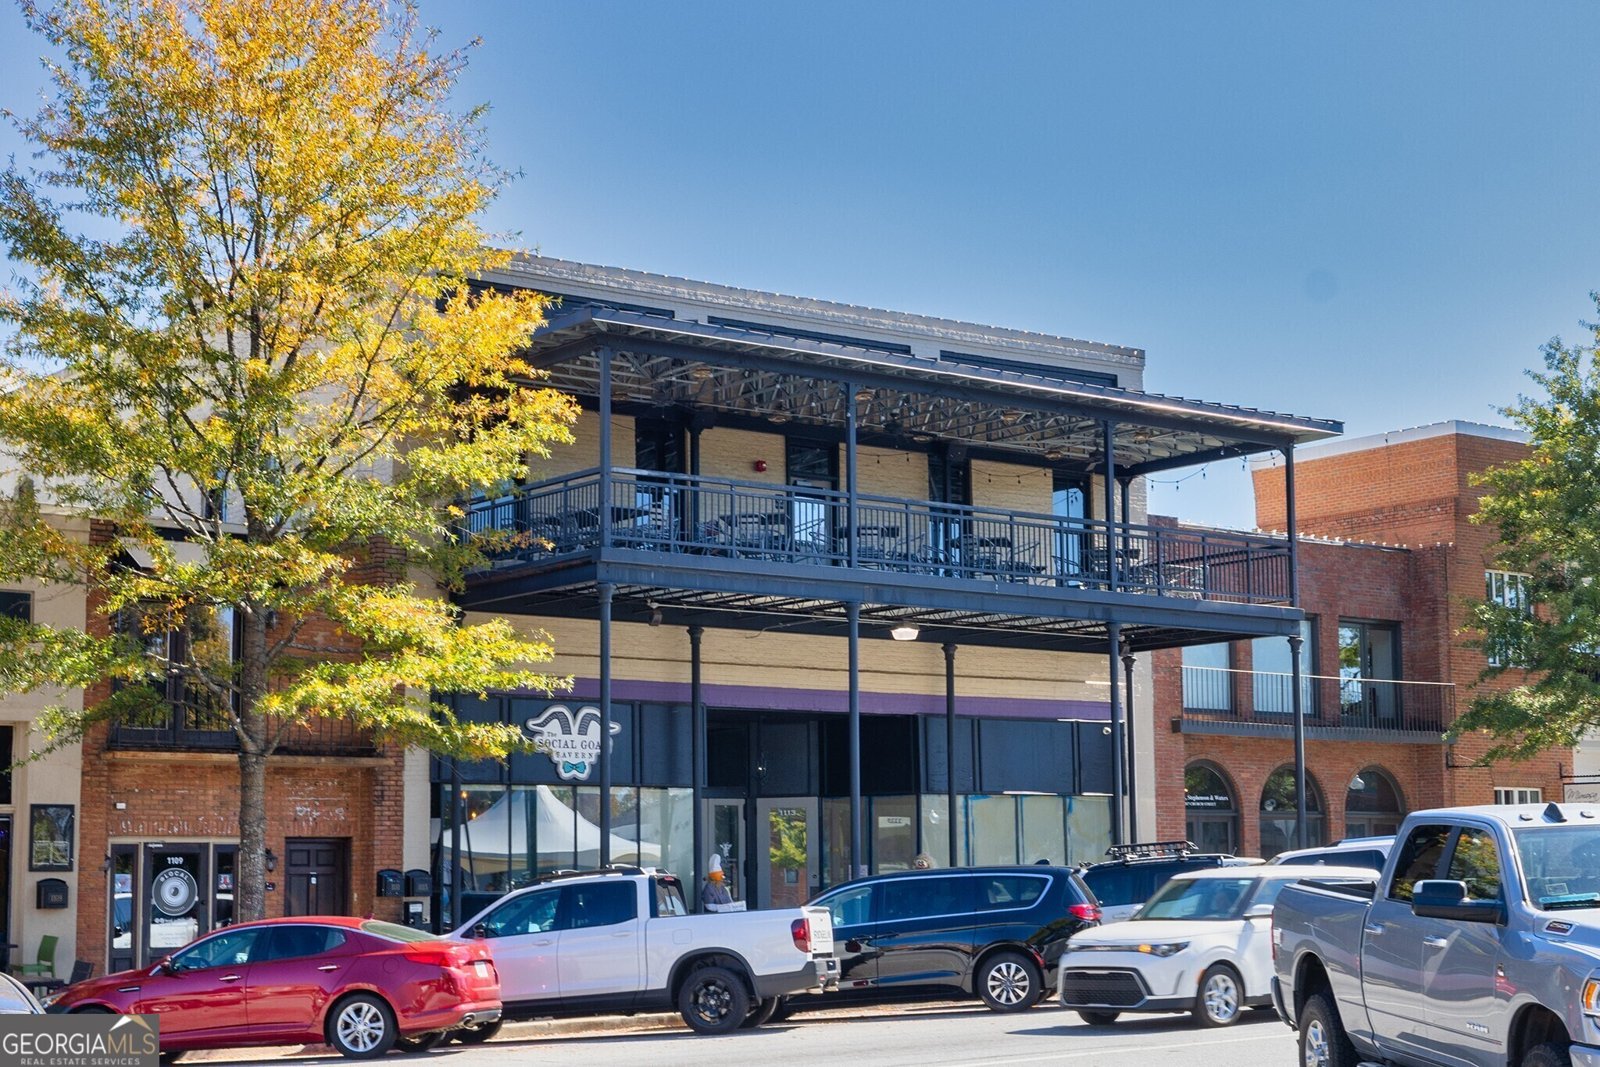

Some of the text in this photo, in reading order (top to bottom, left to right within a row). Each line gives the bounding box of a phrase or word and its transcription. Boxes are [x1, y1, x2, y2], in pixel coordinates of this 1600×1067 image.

[538, 739, 601, 750] SOCIAL GOA
[556, 751, 593, 759] TAVERN
[167, 857, 183, 865] 1109
